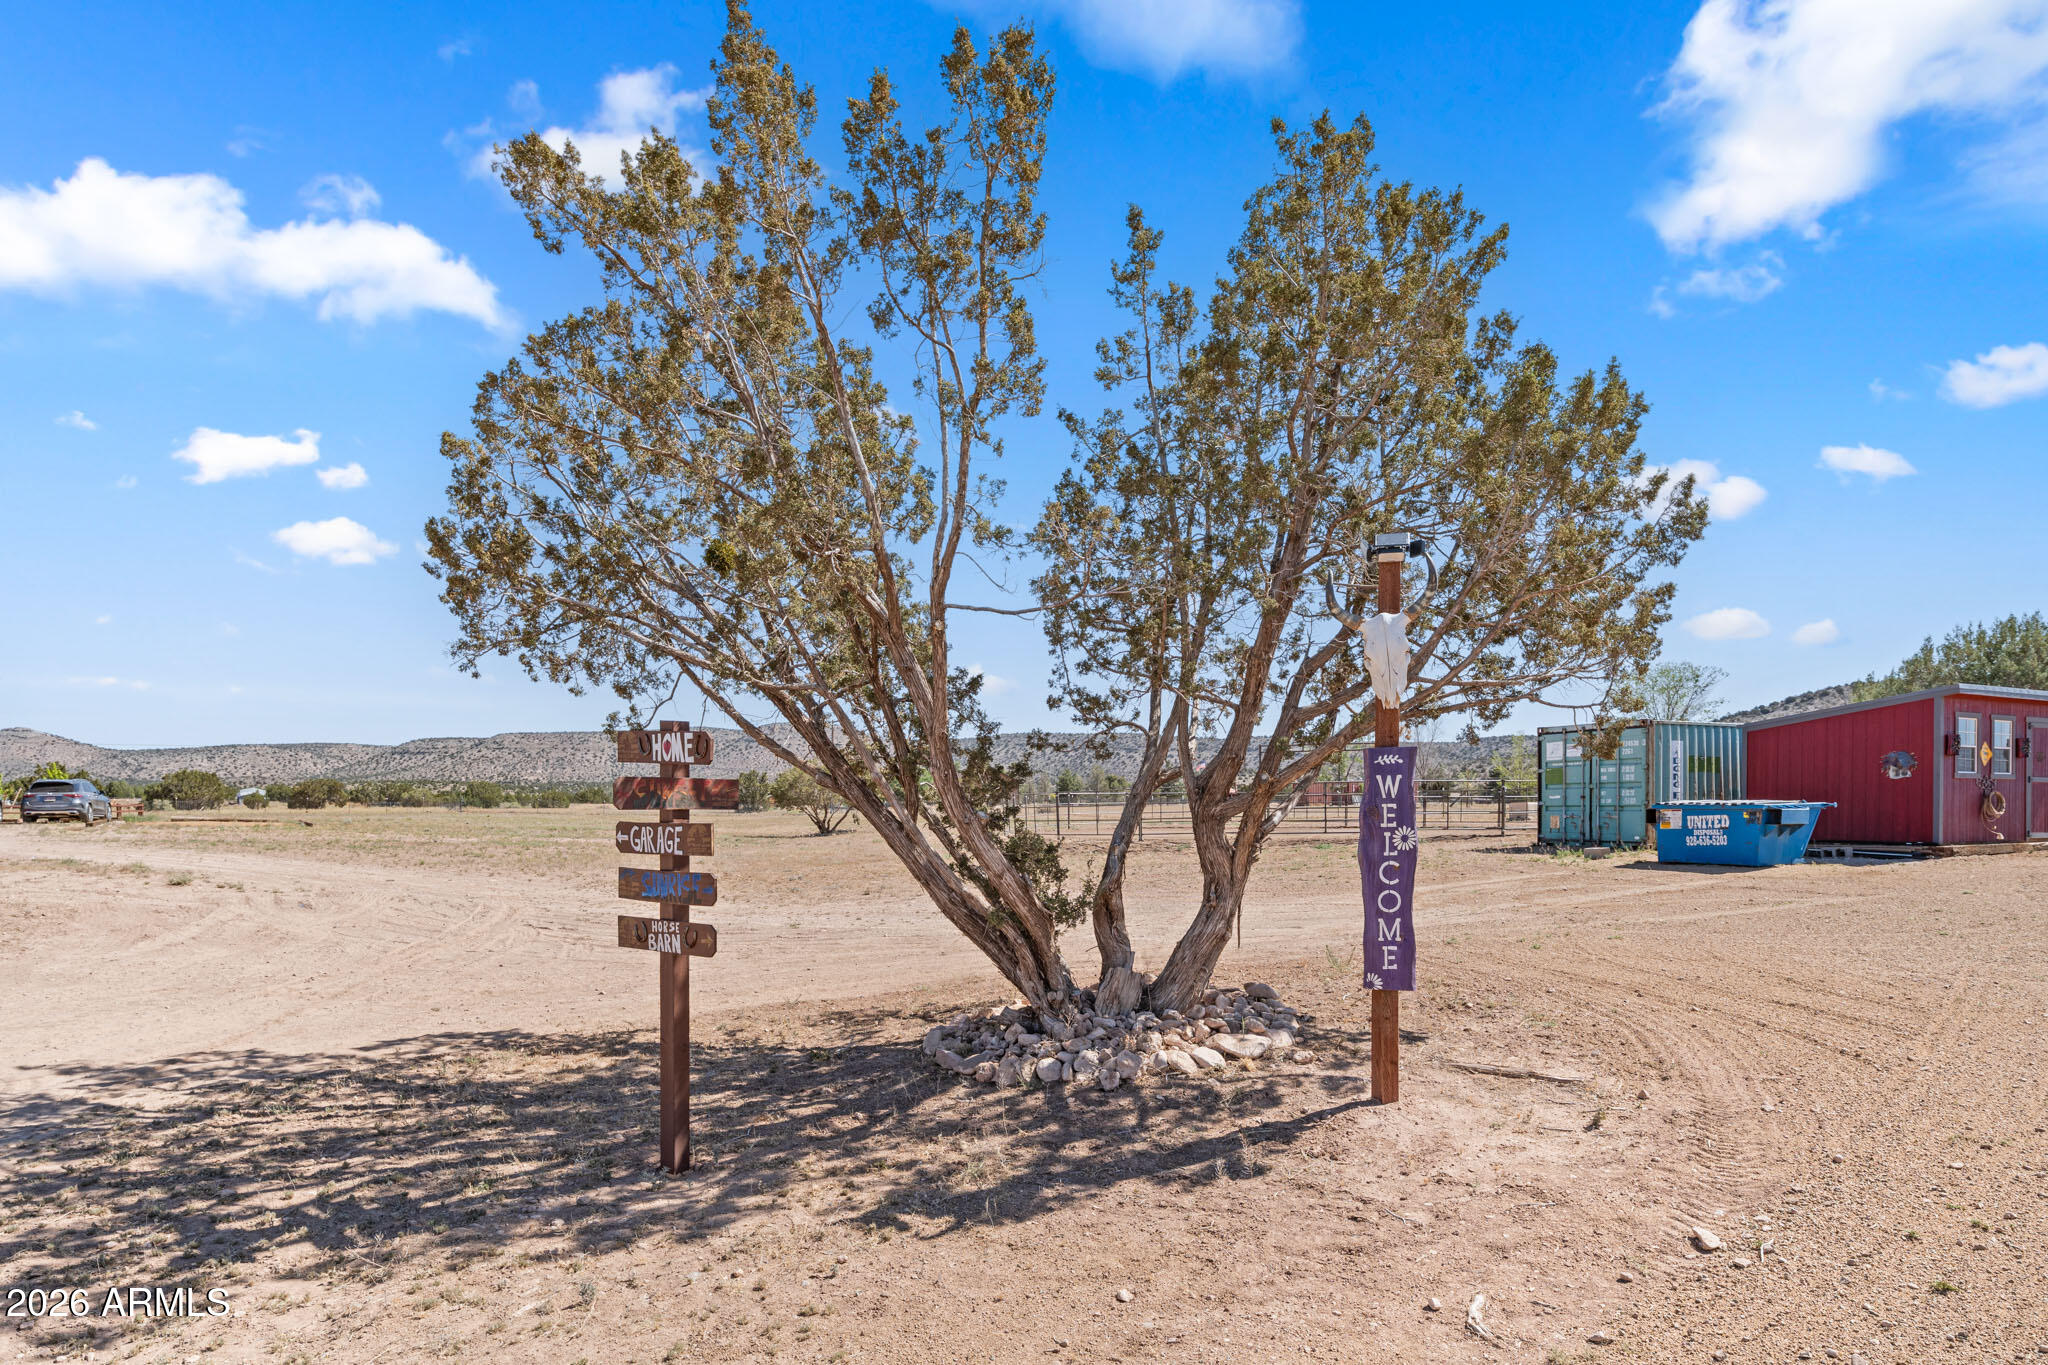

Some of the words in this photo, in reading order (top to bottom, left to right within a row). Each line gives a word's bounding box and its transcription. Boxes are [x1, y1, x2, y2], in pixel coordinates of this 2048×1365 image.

[652, 732, 694, 762] HOME
[1686, 814, 1730, 829] UNITED
[630, 825, 683, 855] GARAGE
[1685, 835, 1728, 846] 928-636-5203
[1375, 774, 1402, 970] WELCOME
[651, 920, 680, 933] HORSE
[648, 934, 682, 954] BARN
